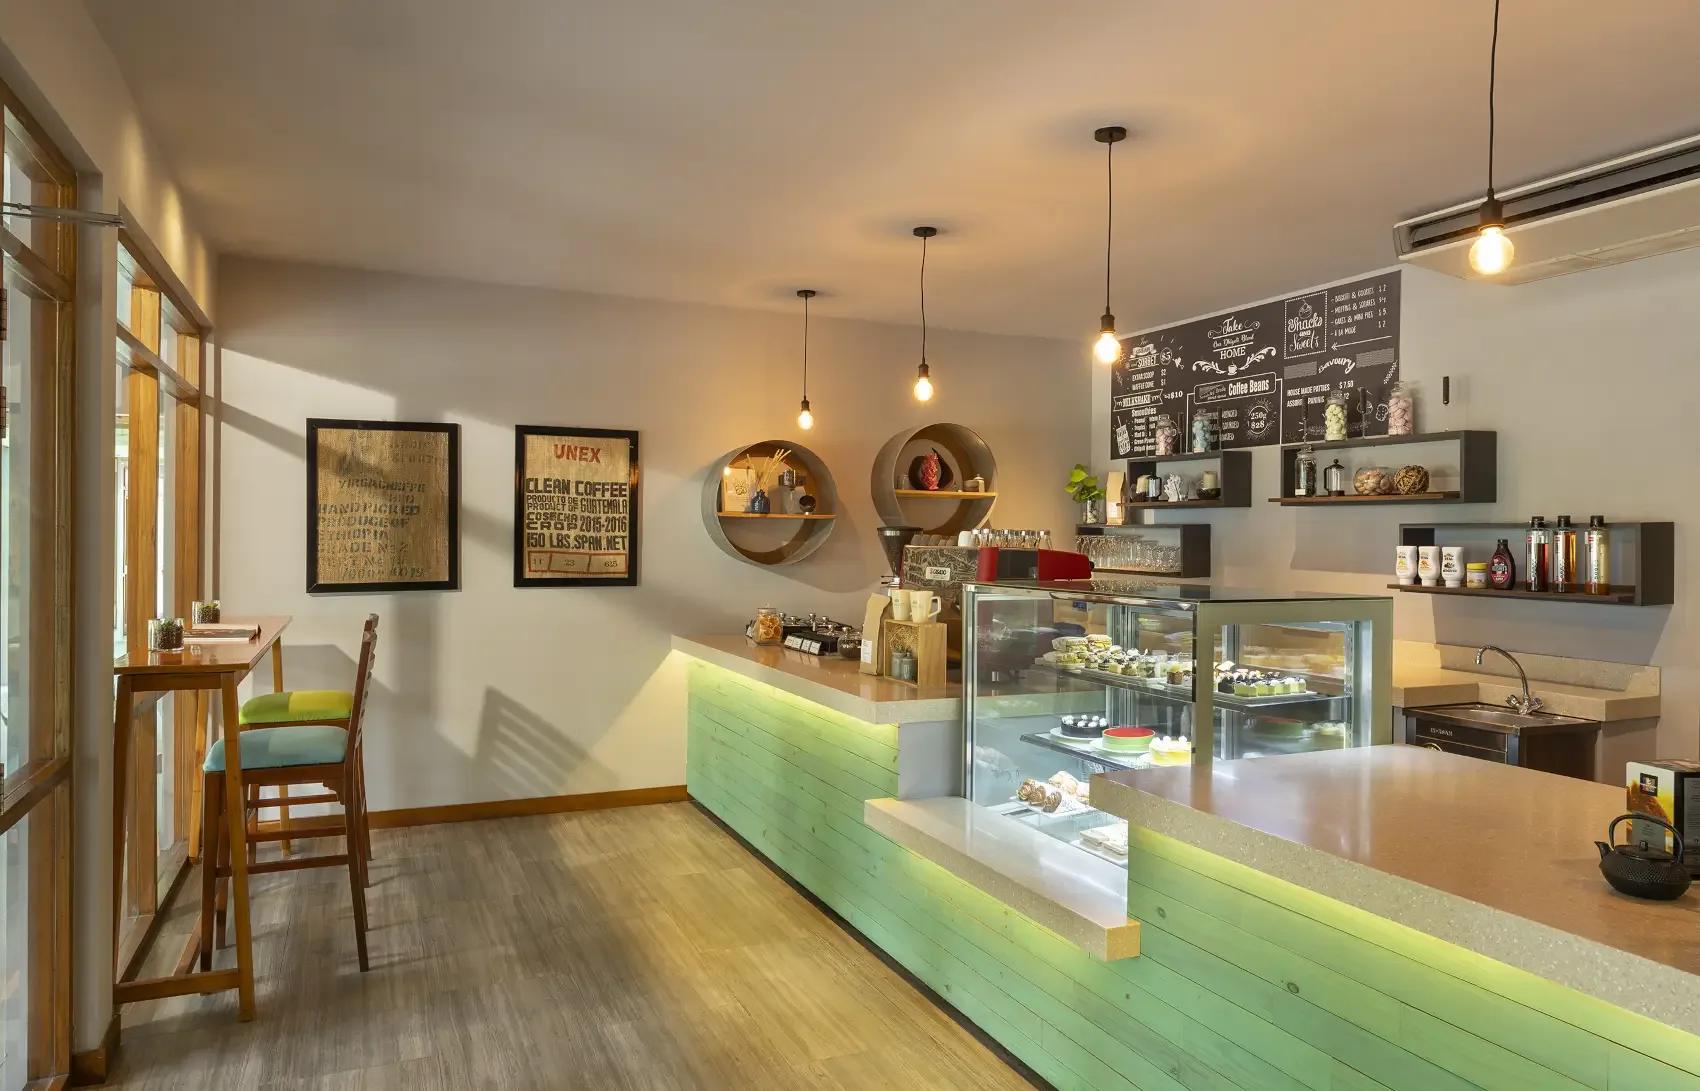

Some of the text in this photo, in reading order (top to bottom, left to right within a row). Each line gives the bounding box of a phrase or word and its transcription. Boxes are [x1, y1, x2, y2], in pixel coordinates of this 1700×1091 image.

[1222, 316, 1243, 335] Take
[1288, 312, 1323, 333] Snacks
[1289, 330, 1320, 352] Sweets
[1220, 346, 1246, 360] HOME
[1228, 381, 1248, 396] Coffee
[1249, 379, 1270, 393] Beans
[1286, 387, 1301, 397] HOUSE
[1301, 385, 1313, 395] MADE
[1122, 394, 1151, 408] MILKSHAKE
[1170, 390, 1183, 400] $10
[1131, 406, 1157, 417] Smoothies
[1250, 420, 1265, 430] $28
[553, 443, 602, 464] UNEX
[526, 477, 628, 498] CLEAN COFFEE
[526, 494, 628, 515] PRODUCTO DE GUATEMALA
[526, 502, 579, 513] PRODUCT OF
[525, 521, 578, 532] CROP
[526, 511, 628, 533] COSECHA 2015-2016
[526, 531, 546, 548] 150
